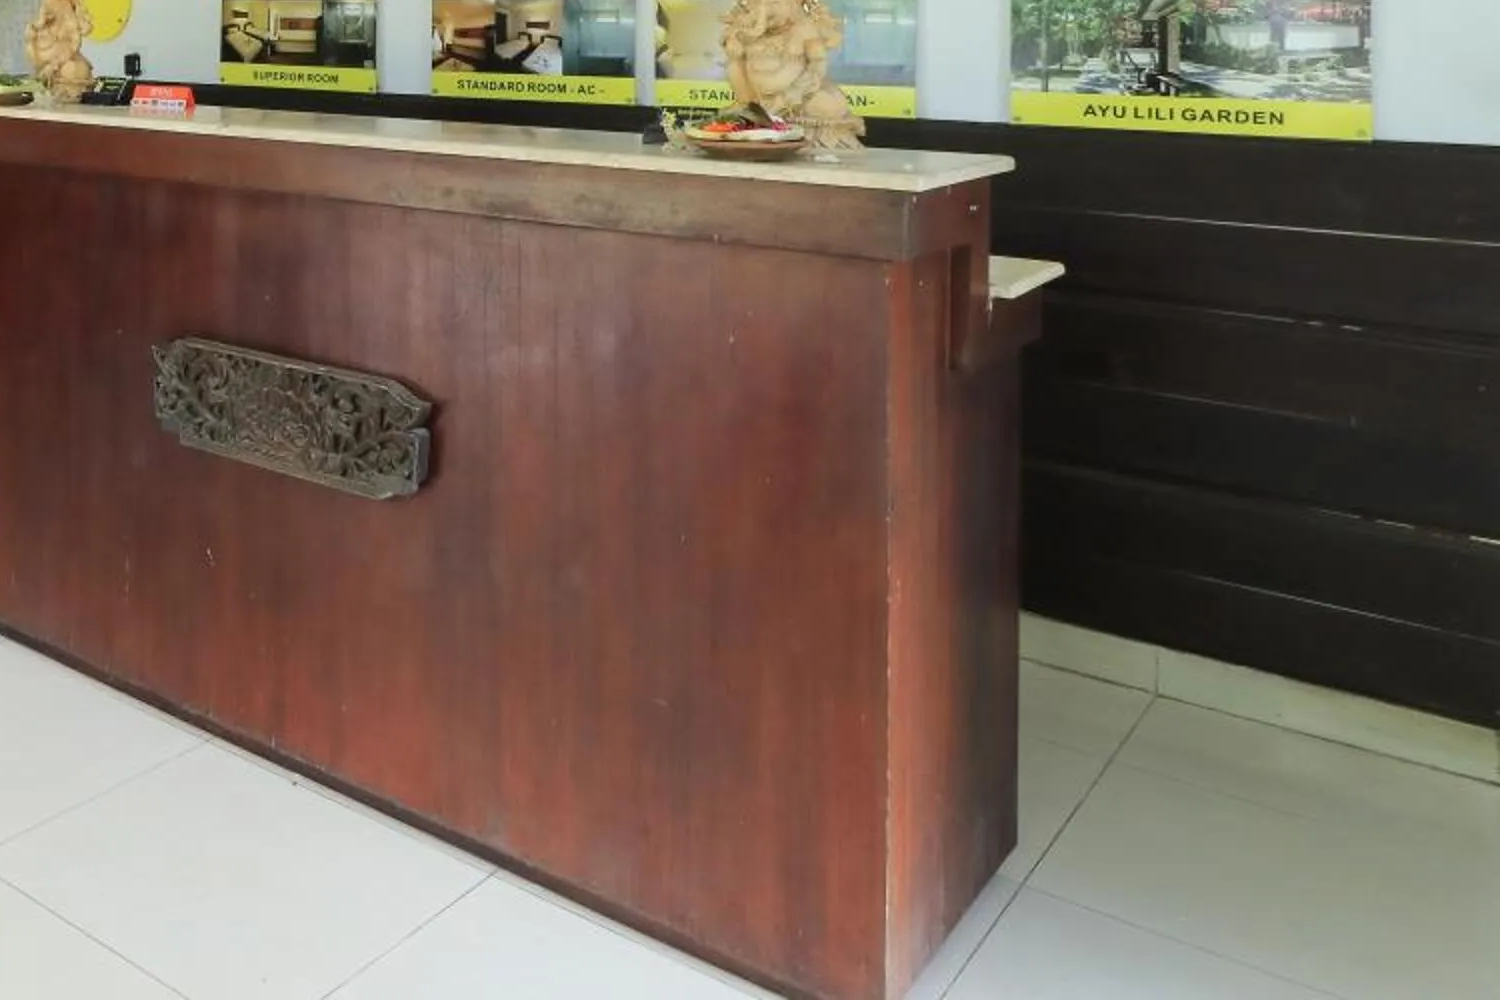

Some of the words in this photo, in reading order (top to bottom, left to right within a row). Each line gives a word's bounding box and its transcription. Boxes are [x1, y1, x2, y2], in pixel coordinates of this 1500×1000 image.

[253, 70, 305, 82] SUPERIOR
[307, 73, 339, 83] ROOM
[457, 79, 524, 93] STANDARD
[527, 82, 566, 94] ROOM
[577, 84, 595, 95] AC
[1083, 104, 1126, 119] AYU
[1133, 106, 1174, 121] LILI
[1181, 107, 1285, 125] GARDEN
